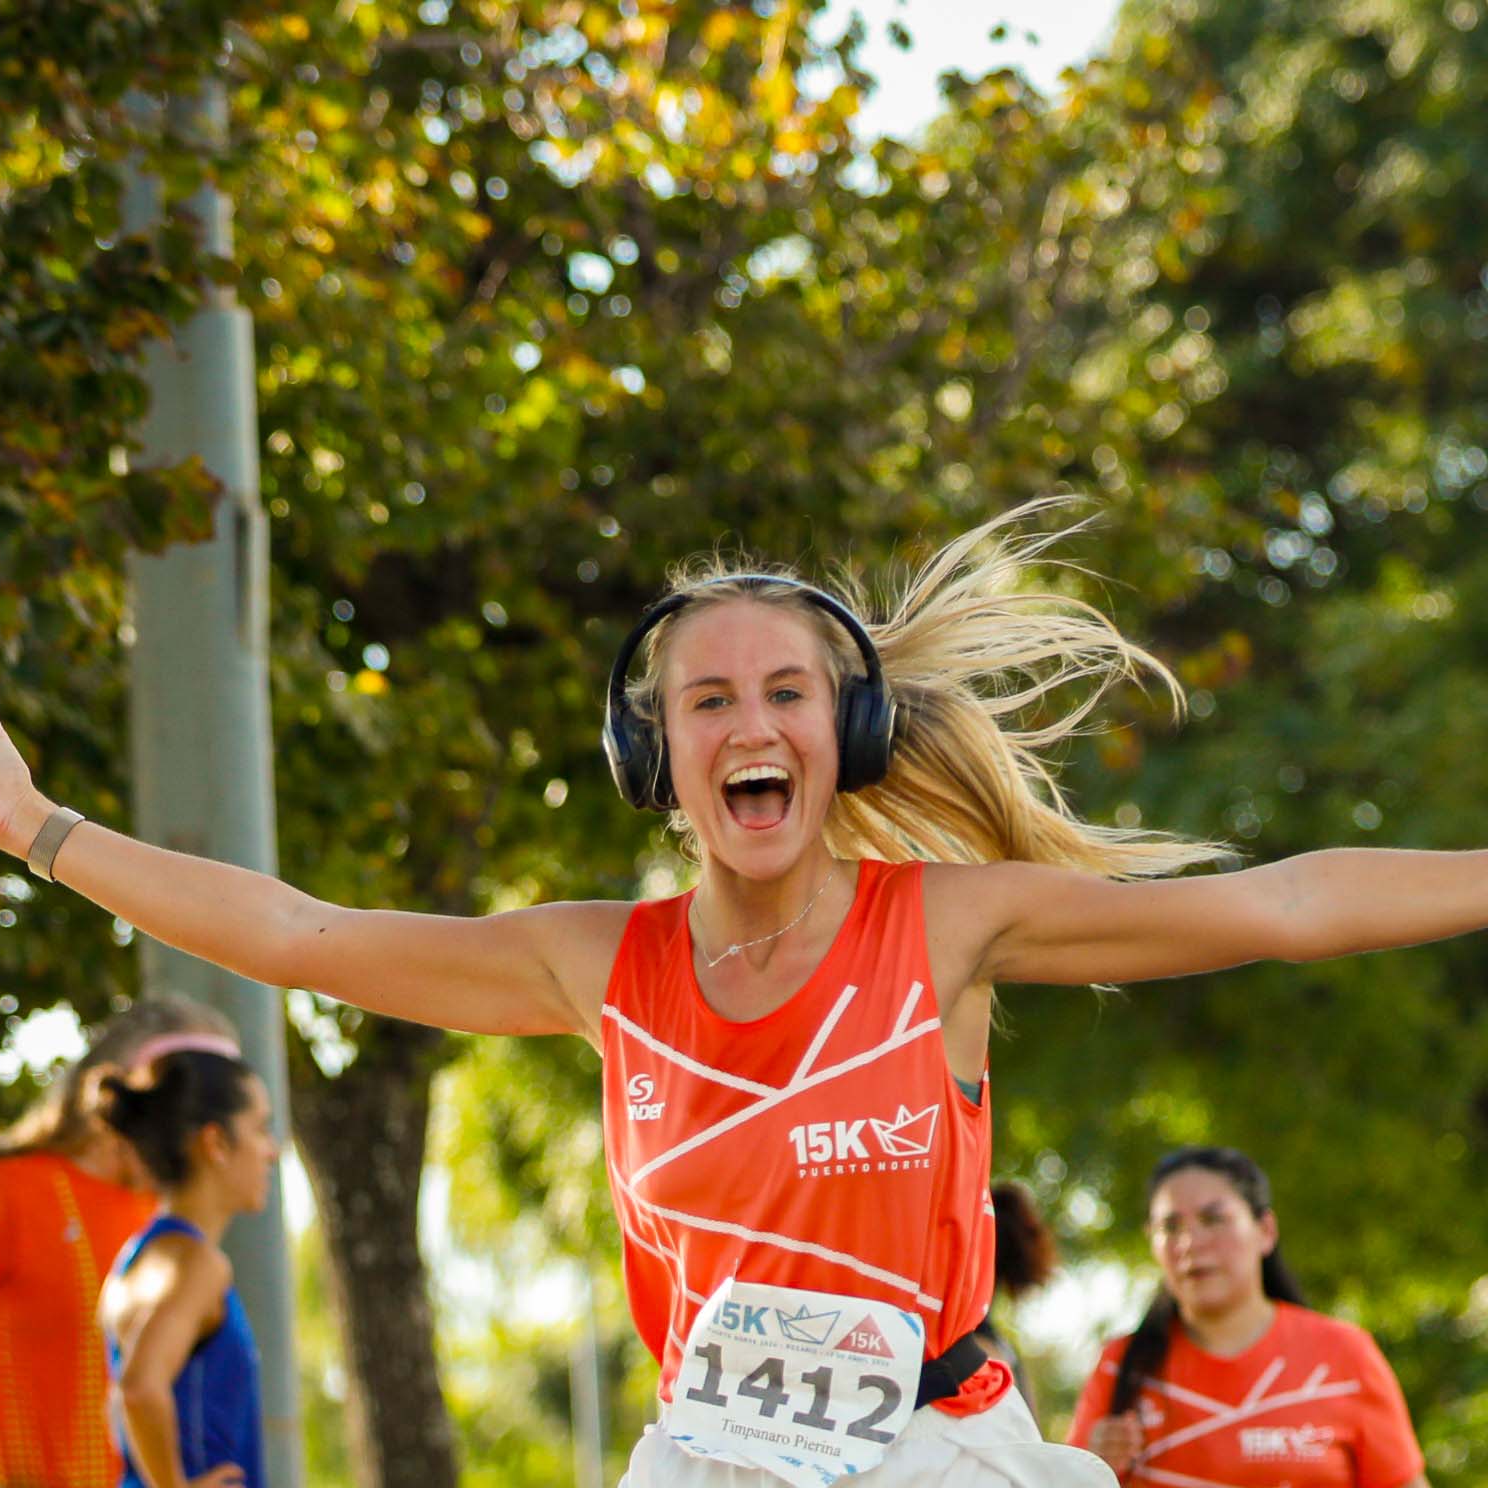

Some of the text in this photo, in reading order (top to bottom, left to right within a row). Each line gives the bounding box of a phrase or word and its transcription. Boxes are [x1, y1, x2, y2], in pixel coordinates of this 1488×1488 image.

[788, 1119, 870, 1164] 15K
[799, 1158, 930, 1179] PUERTO NORTE
[849, 1331, 882, 1351] 15K
[686, 1342, 902, 1445] 1412
[721, 1417, 841, 1457] Timpanaro Pierina
